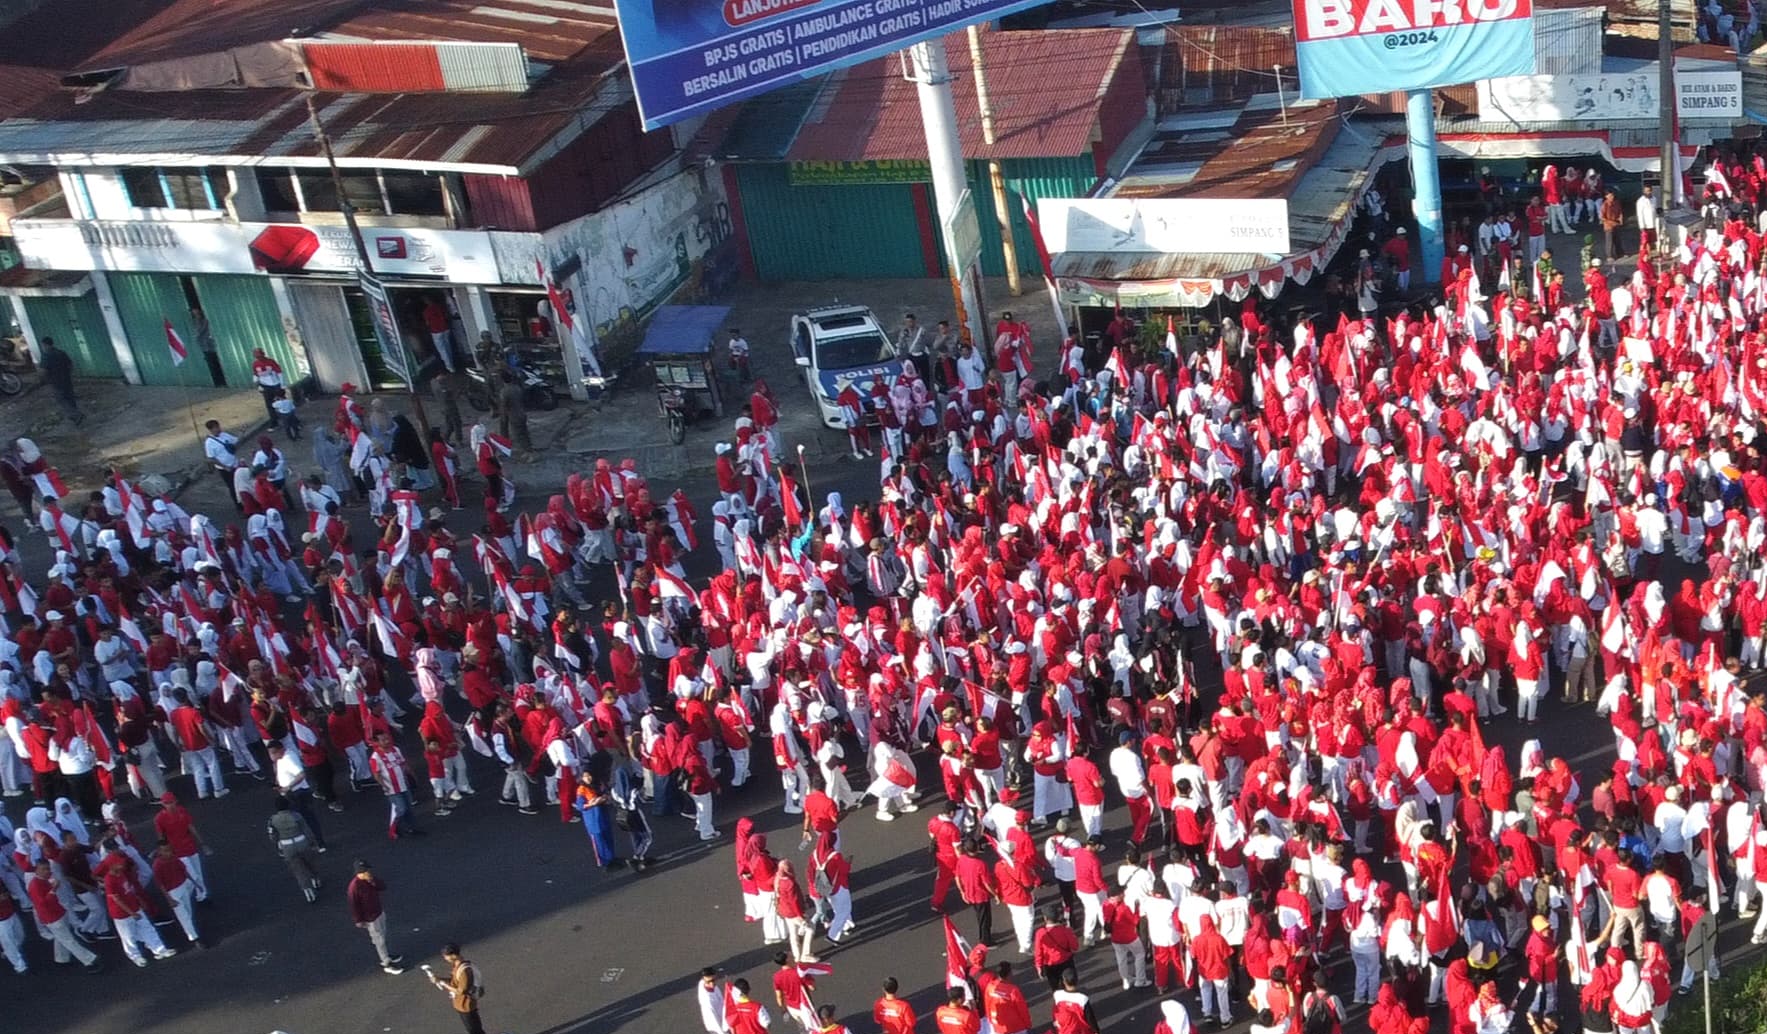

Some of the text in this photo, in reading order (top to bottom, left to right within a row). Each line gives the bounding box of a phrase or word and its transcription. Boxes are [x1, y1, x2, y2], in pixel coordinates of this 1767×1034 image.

[704, 43, 738, 67] BPJS
[740, 29, 785, 55] GRATIS
[795, 3, 874, 39] AMBULANCE
[1384, 30, 1438, 49] @2024
[683, 63, 747, 96] BERSALIN
[749, 49, 794, 75] GRATIS
[802, 23, 877, 59] PENDIDIKAN
[879, 11, 921, 35] GRATIS
[1682, 96, 1738, 108] SIMPANG 5
[1230, 227, 1275, 238] SIMPANG
[835, 366, 890, 381] POLISI
